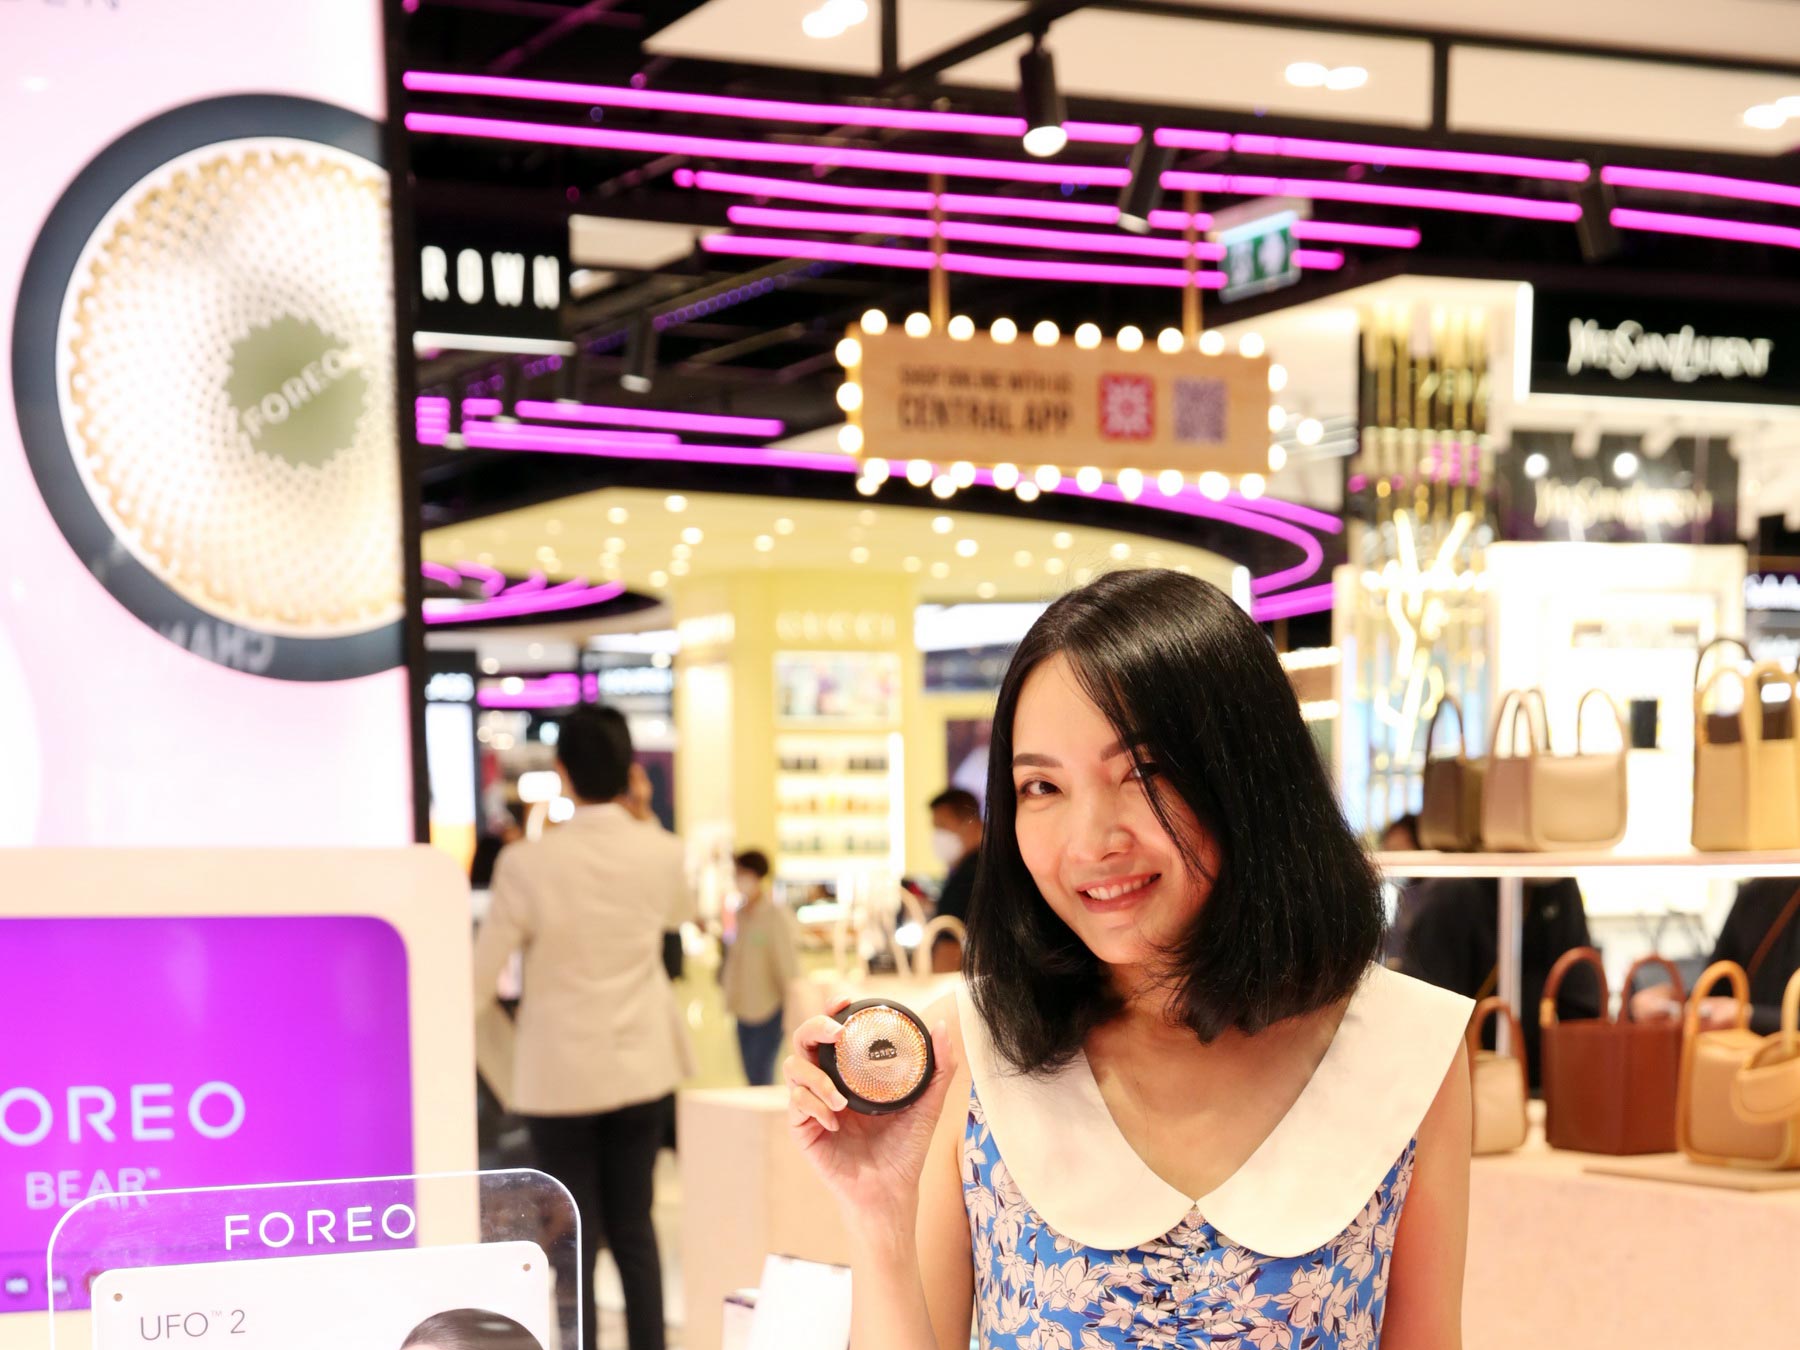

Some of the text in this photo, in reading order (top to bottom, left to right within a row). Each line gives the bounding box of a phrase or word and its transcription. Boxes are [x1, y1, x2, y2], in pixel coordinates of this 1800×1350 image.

[243, 349, 345, 439] FOREO
[898, 394, 1074, 438] CENTRAL APP
[225, 1203, 417, 1250] FOREO
[229, 1309, 247, 1335] 2
